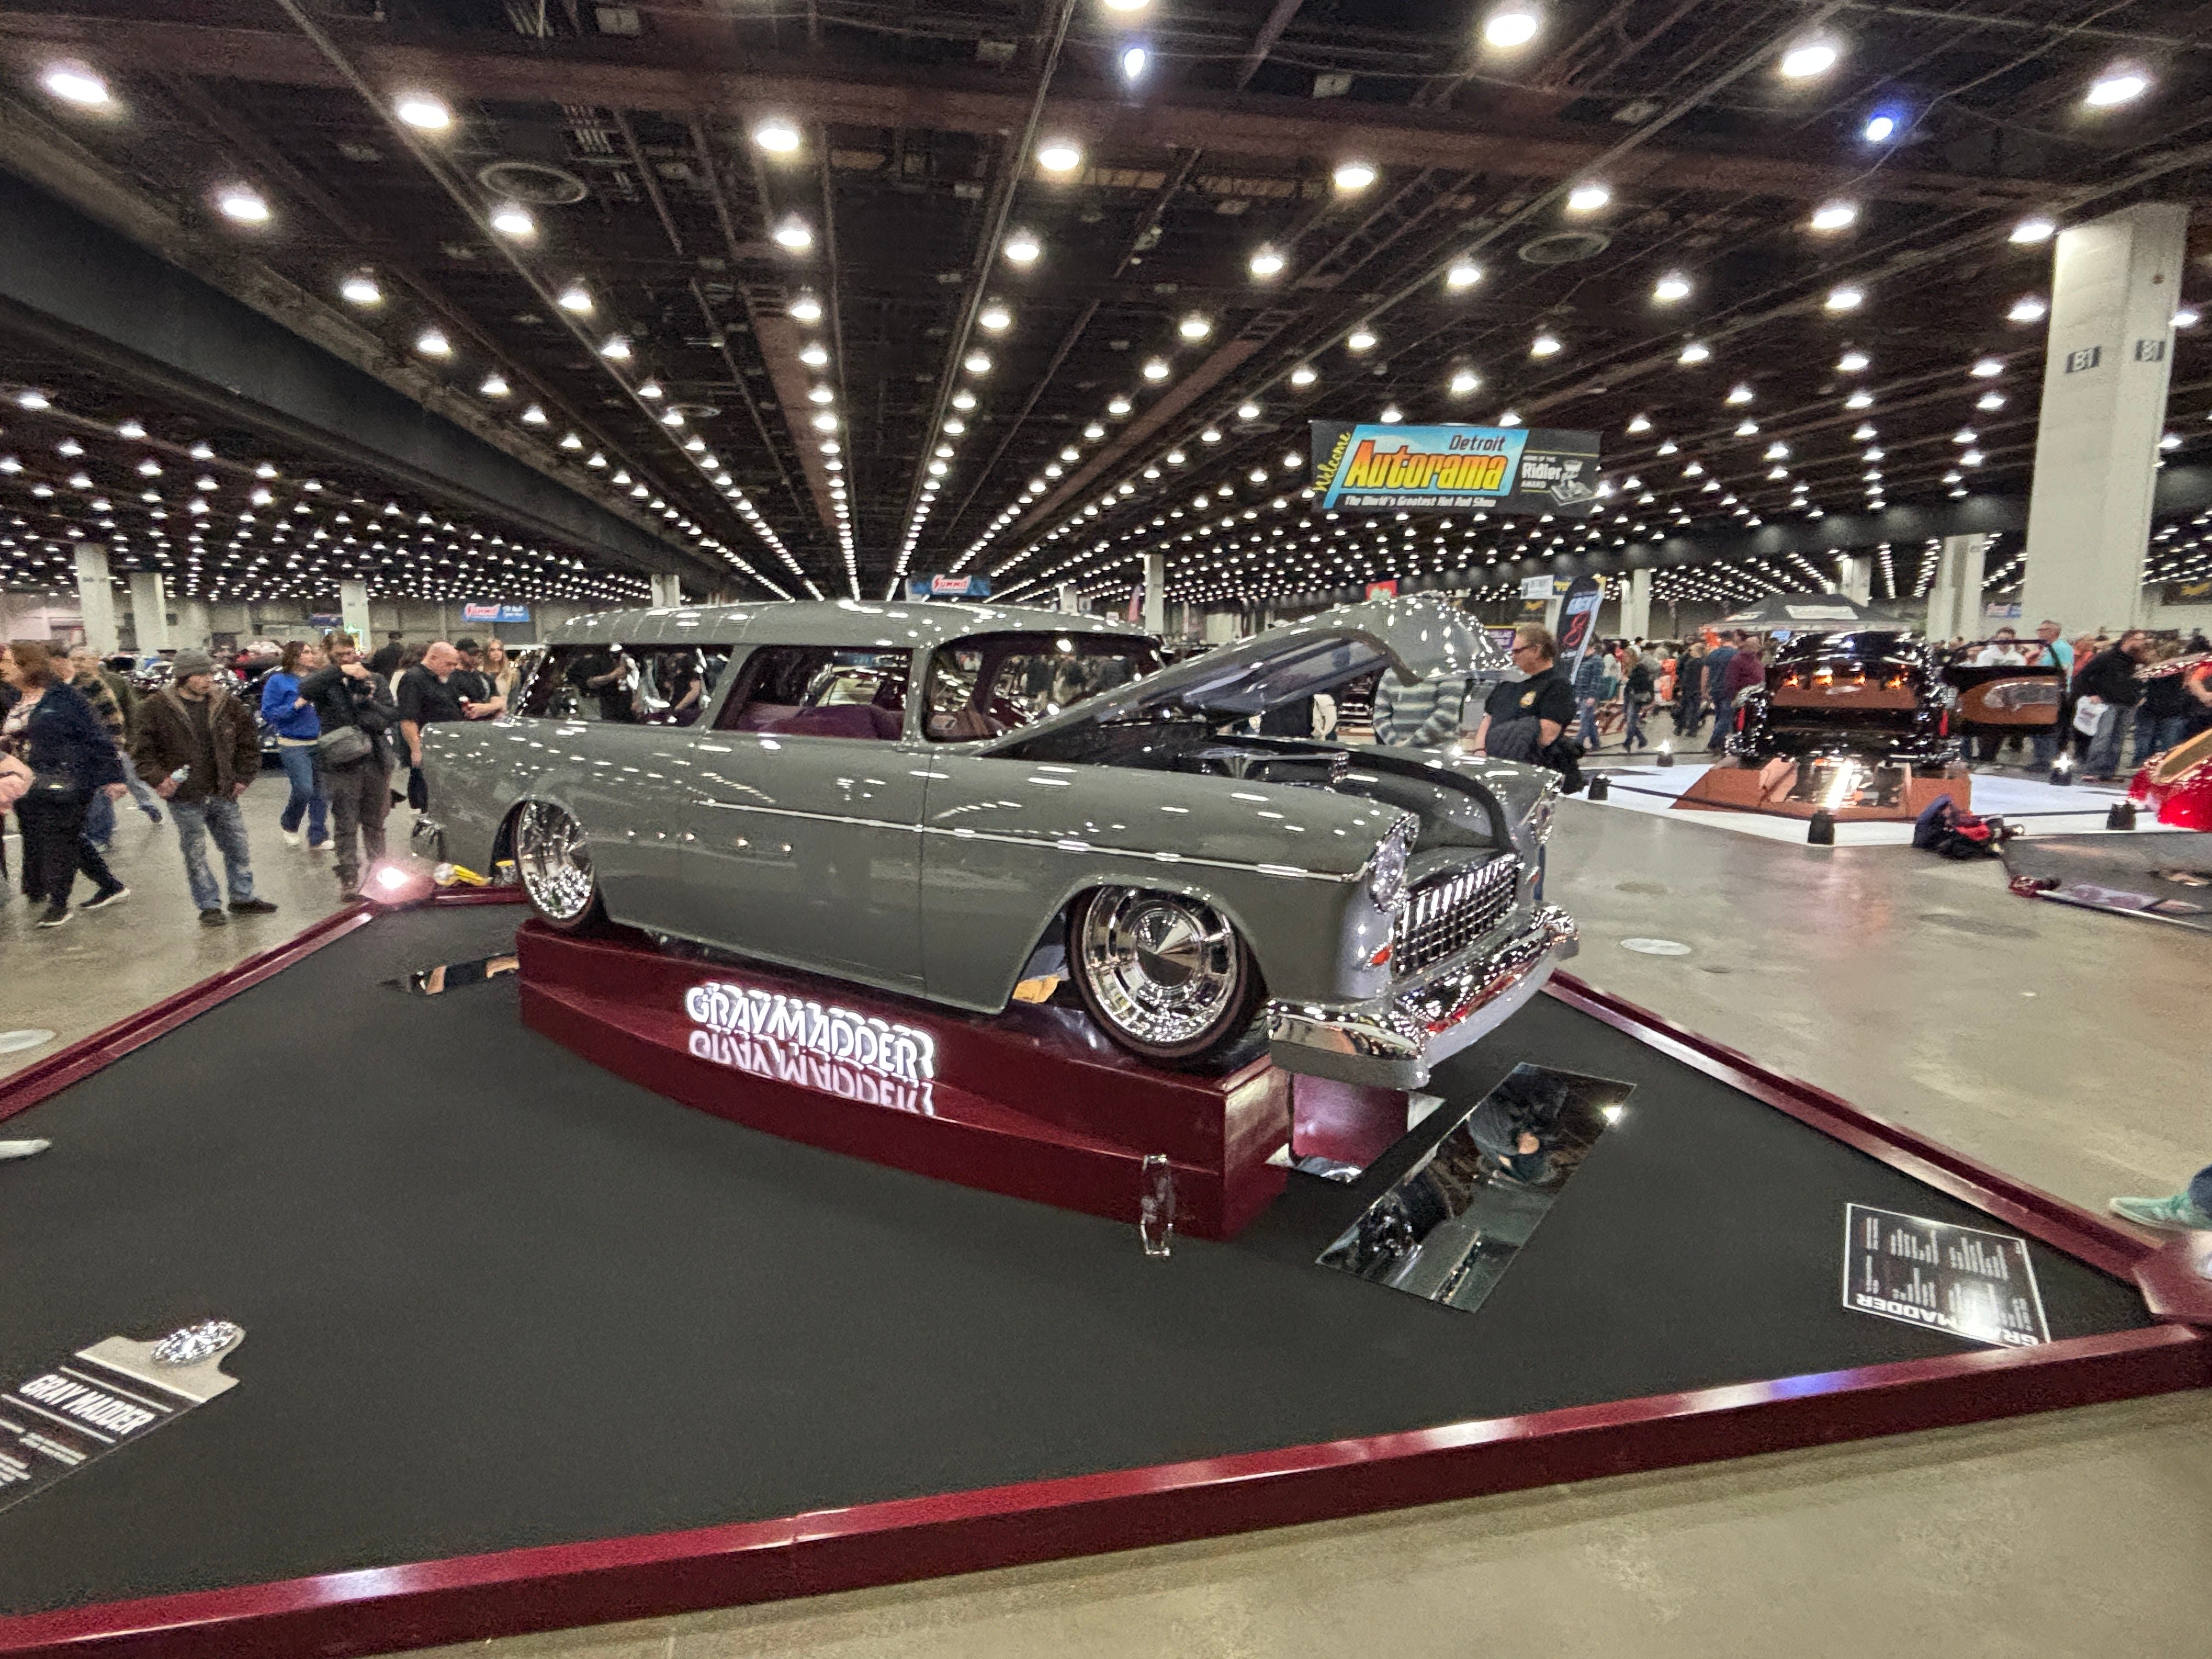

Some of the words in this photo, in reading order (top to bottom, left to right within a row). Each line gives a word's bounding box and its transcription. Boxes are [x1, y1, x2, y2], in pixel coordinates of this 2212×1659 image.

[2073, 348, 2094, 371] B1
[1448, 434, 1506, 452] Detroit
[1312, 432, 1351, 492] Welcome
[1341, 439, 1508, 491] Autorama
[1522, 462, 1562, 480] Ridler
[1345, 495, 1362, 506] The
[1396, 495, 1437, 507] Greatest
[1855, 1293, 1957, 1329] MADDER
[19, 1374, 90, 1406] GRAY
[61, 1390, 156, 1435] MADDER
